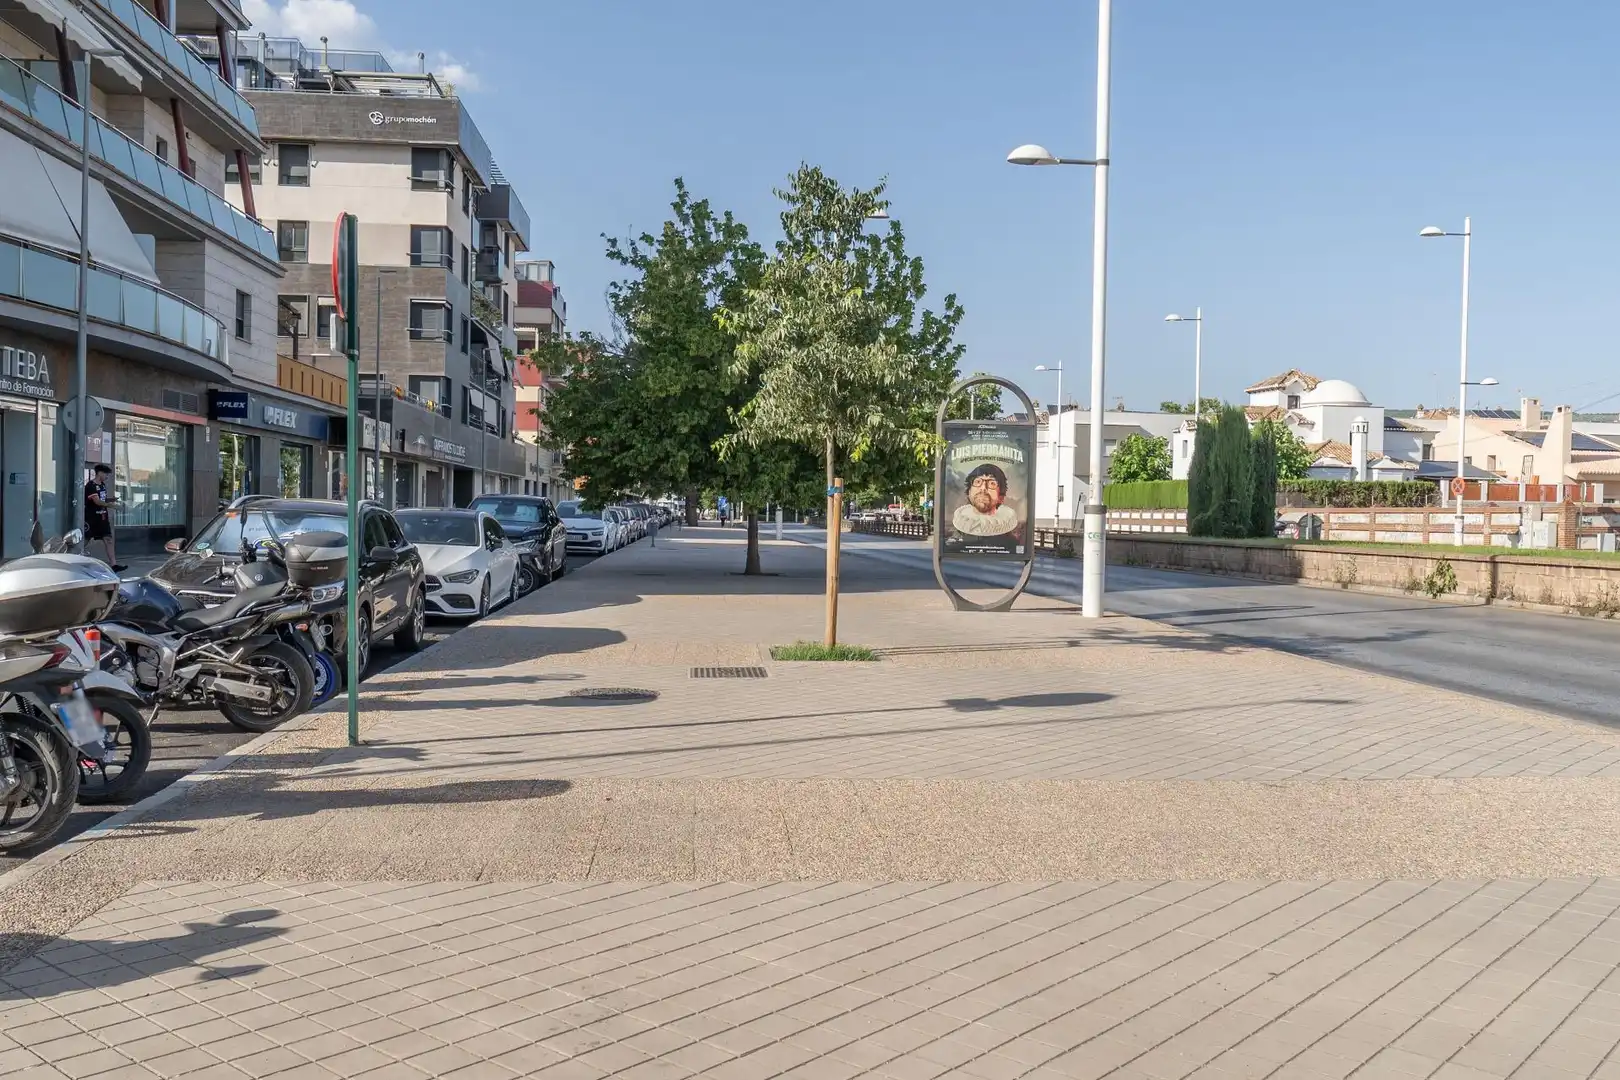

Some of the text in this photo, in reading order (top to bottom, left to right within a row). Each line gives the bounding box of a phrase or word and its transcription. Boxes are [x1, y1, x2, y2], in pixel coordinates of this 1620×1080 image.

[385, 116, 437, 124] grupomochón
[13, 381, 22, 392] de
[23, 382, 54, 398] Formación
[222, 401, 246, 409] FLEX
[273, 408, 298, 428] FLEX
[951, 444, 1024, 463] LUIS PIEDRAHITA
